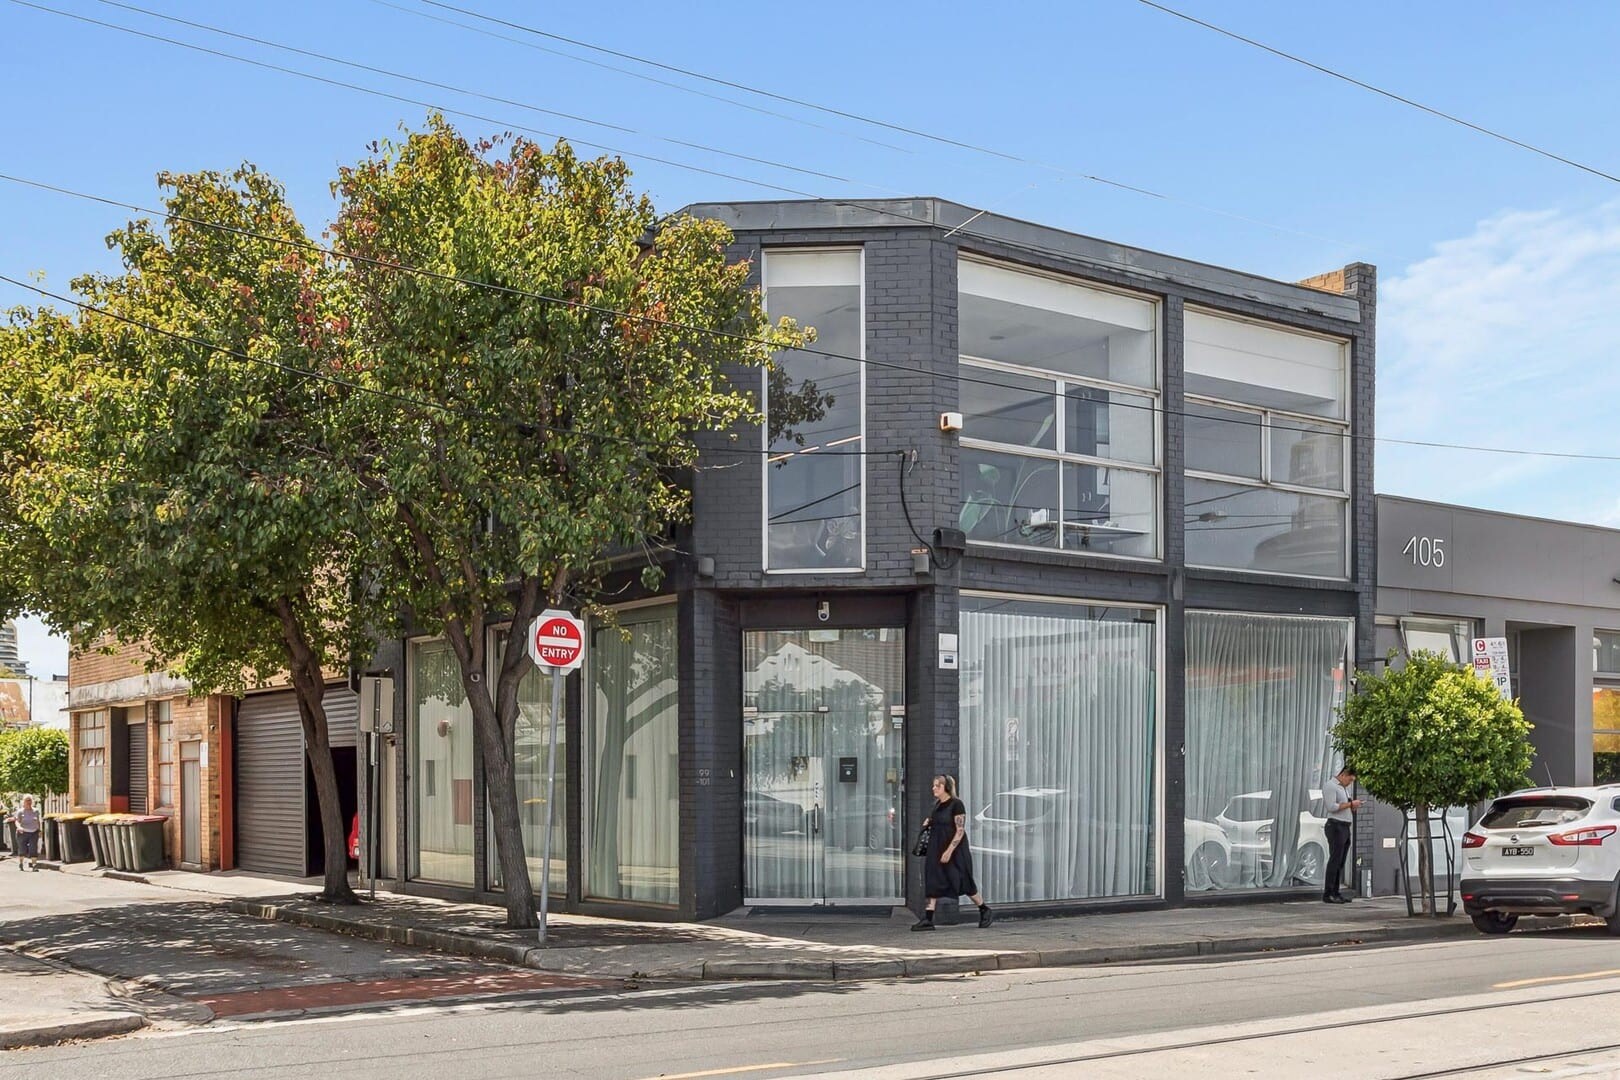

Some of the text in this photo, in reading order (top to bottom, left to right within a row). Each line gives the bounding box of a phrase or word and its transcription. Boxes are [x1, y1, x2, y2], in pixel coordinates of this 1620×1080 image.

[1402, 535, 1444, 567] 105
[552, 625, 567, 636] NO
[542, 647, 574, 660] ENTRY
[1496, 676, 1507, 686] 1P
[699, 769, 709, 777] 99
